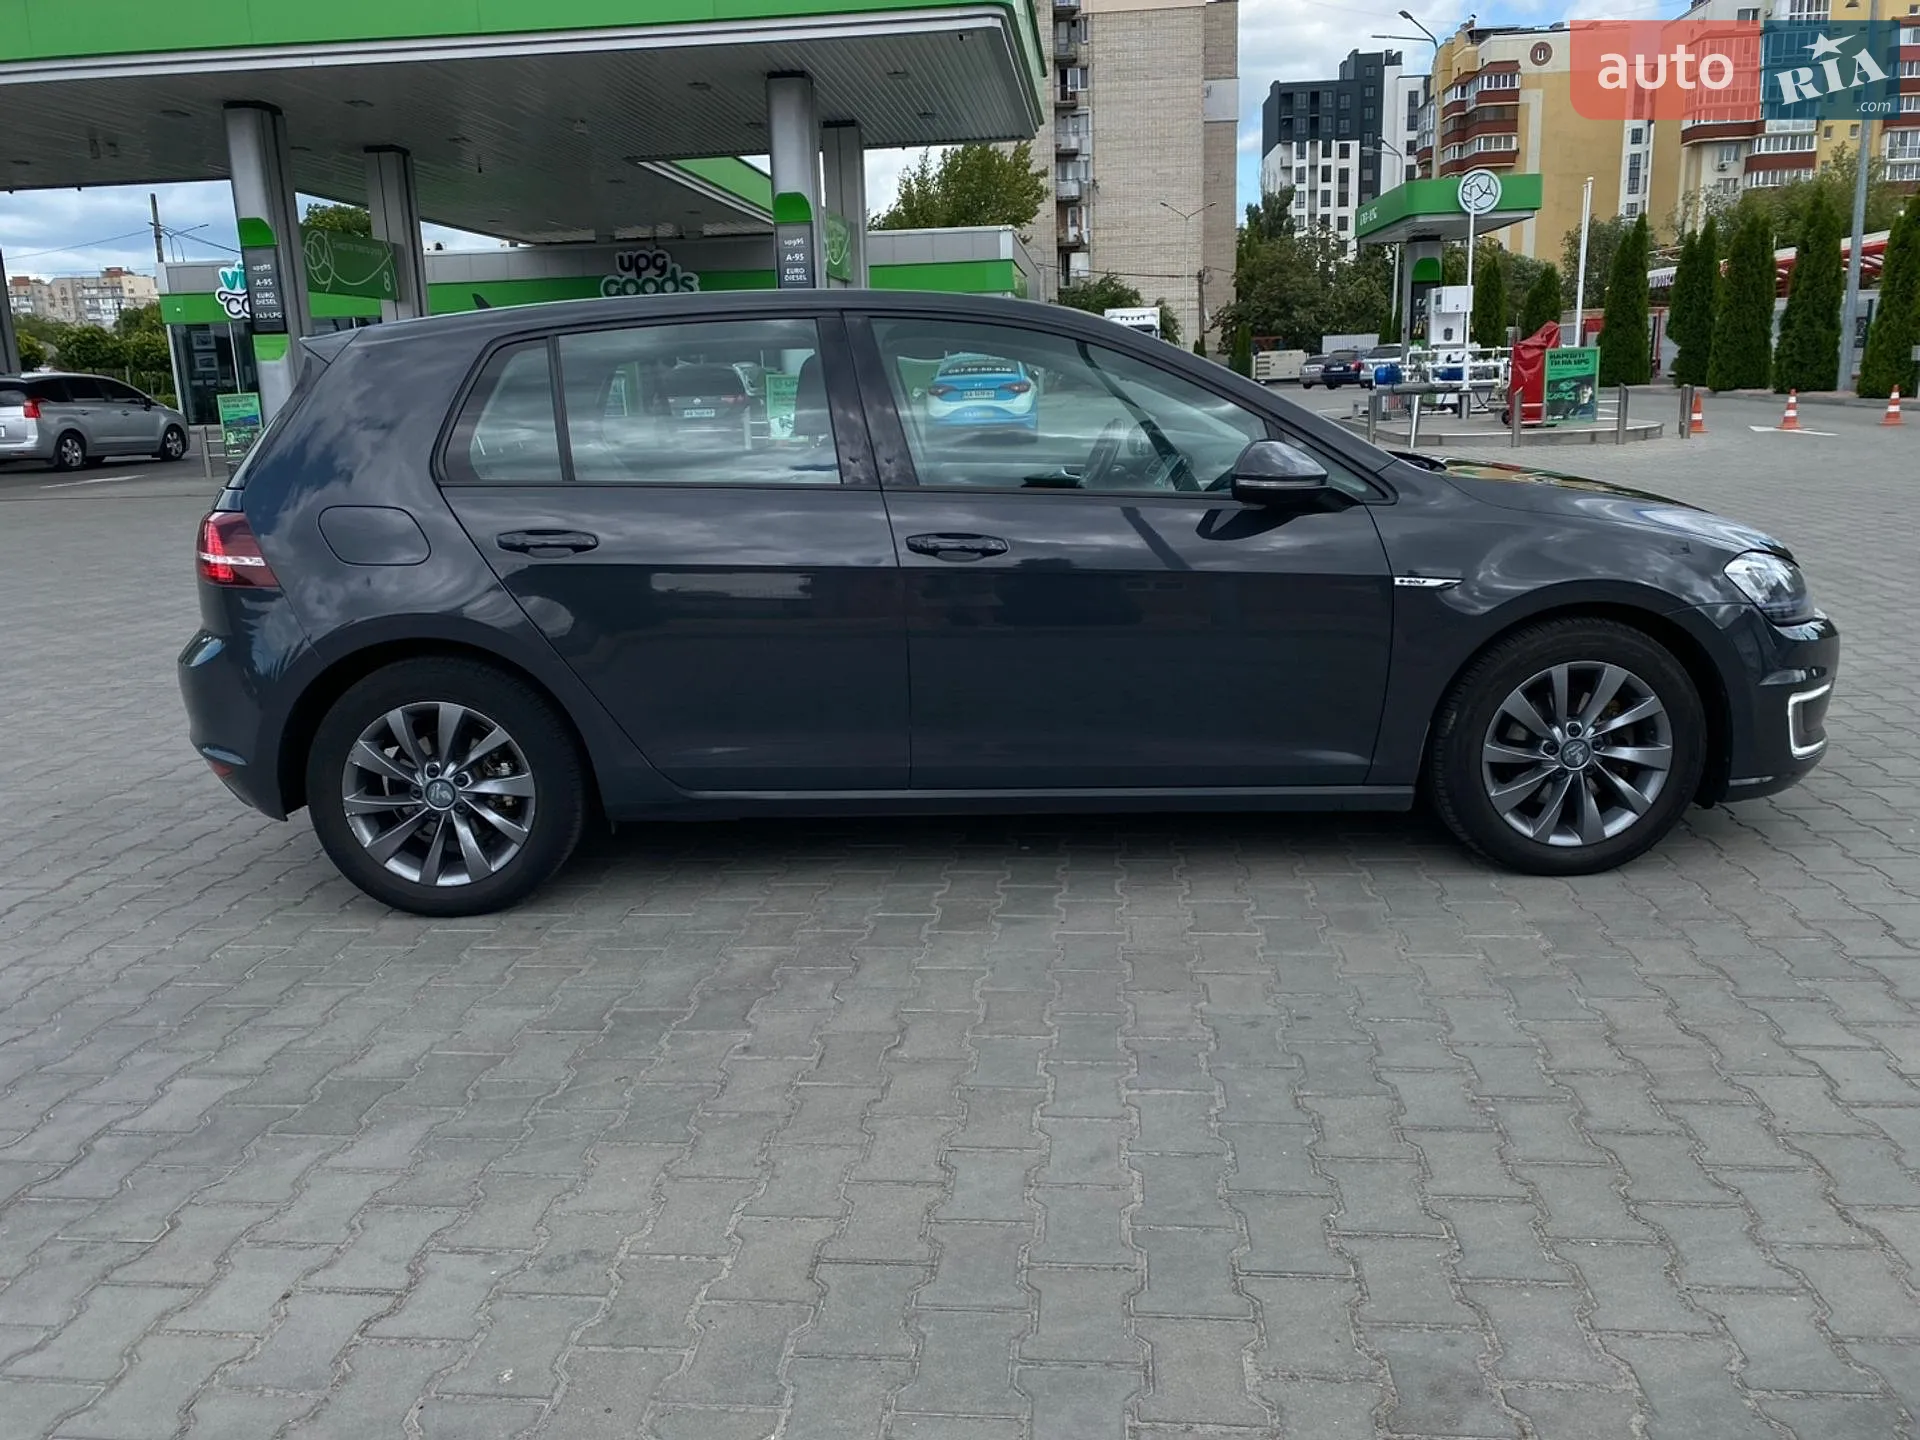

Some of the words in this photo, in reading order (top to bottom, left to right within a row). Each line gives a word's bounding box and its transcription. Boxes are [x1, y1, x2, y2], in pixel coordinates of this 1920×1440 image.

[618, 253, 668, 279] upg
[786, 267, 806, 275] EURO
[383, 271, 392, 292] 8
